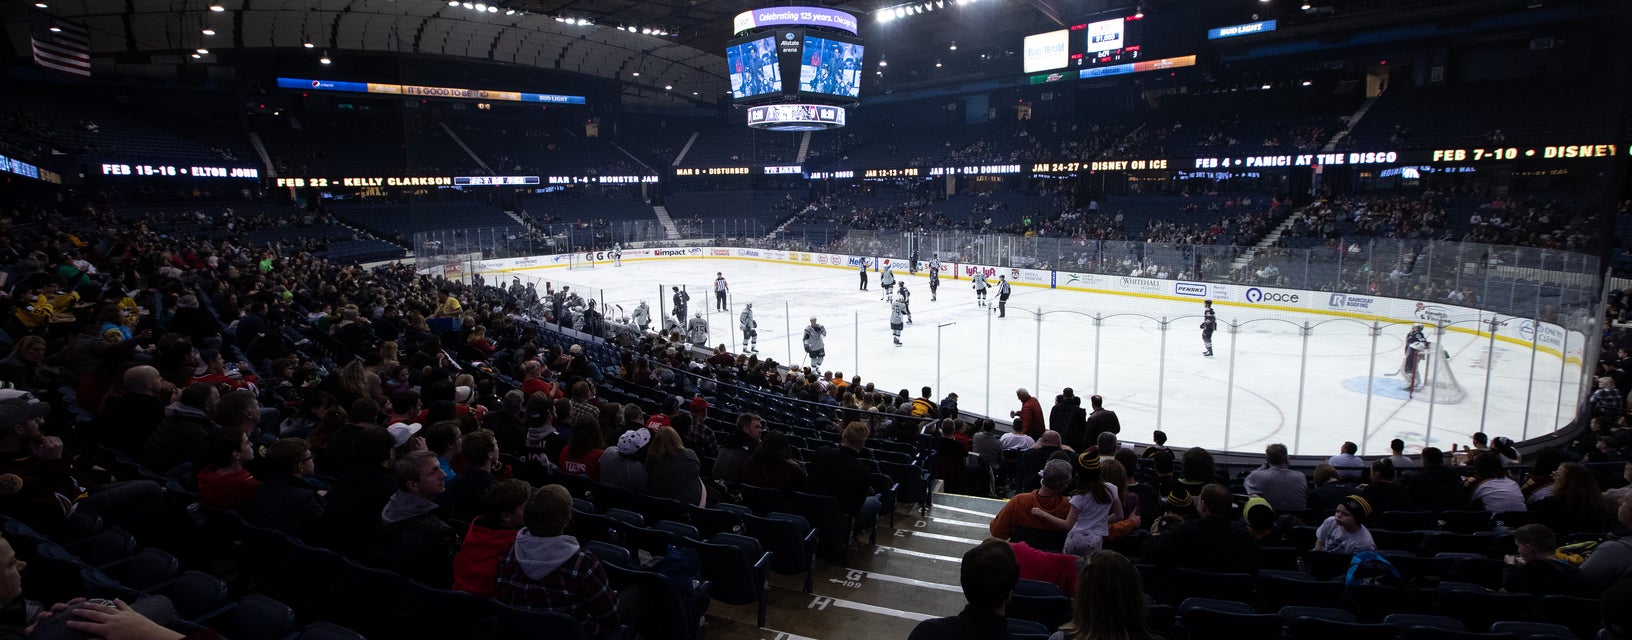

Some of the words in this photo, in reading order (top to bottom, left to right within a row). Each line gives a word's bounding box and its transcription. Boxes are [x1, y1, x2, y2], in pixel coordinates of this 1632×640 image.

[759, 11, 798, 22] Celebrating
[800, 12, 812, 20] 125
[813, 12, 832, 23] years.
[1220, 28, 1237, 36] BUD
[1238, 24, 1262, 33] LIGHT
[423, 88, 449, 96] GOOD
[1433, 149, 1466, 161] FEB
[1473, 148, 1517, 160] 7-10
[1544, 144, 1617, 158] DISNEY
[1195, 158, 1218, 168] FEB
[1222, 158, 1230, 167] 4
[1246, 156, 1290, 167] PANIC!
[1295, 155, 1313, 165] AT
[1316, 154, 1344, 164] THE
[1350, 152, 1397, 164] DISCO
[102, 164, 130, 175] FEB
[136, 165, 176, 176] 15-16
[190, 166, 227, 177] ELTON
[230, 167, 258, 177] JOHN
[981, 165, 1020, 173] DOMINION
[1032, 164, 1050, 172] JAN
[1052, 163, 1079, 171] 24-27
[1092, 161, 1128, 170] DISNEY
[1131, 160, 1146, 169] ON
[1150, 160, 1168, 169] ICE
[277, 178, 304, 187] FEB
[344, 178, 383, 186] KELLY
[387, 177, 451, 186] CLARKSON
[966, 266, 978, 276] lyft
[983, 267, 996, 278] lyft
[1264, 292, 1299, 302] pace
[694, 326, 704, 334] 45
[874, 546, 891, 555] F
[846, 570, 863, 581] G
[843, 580, 862, 589] 109
[808, 596, 832, 610] H
